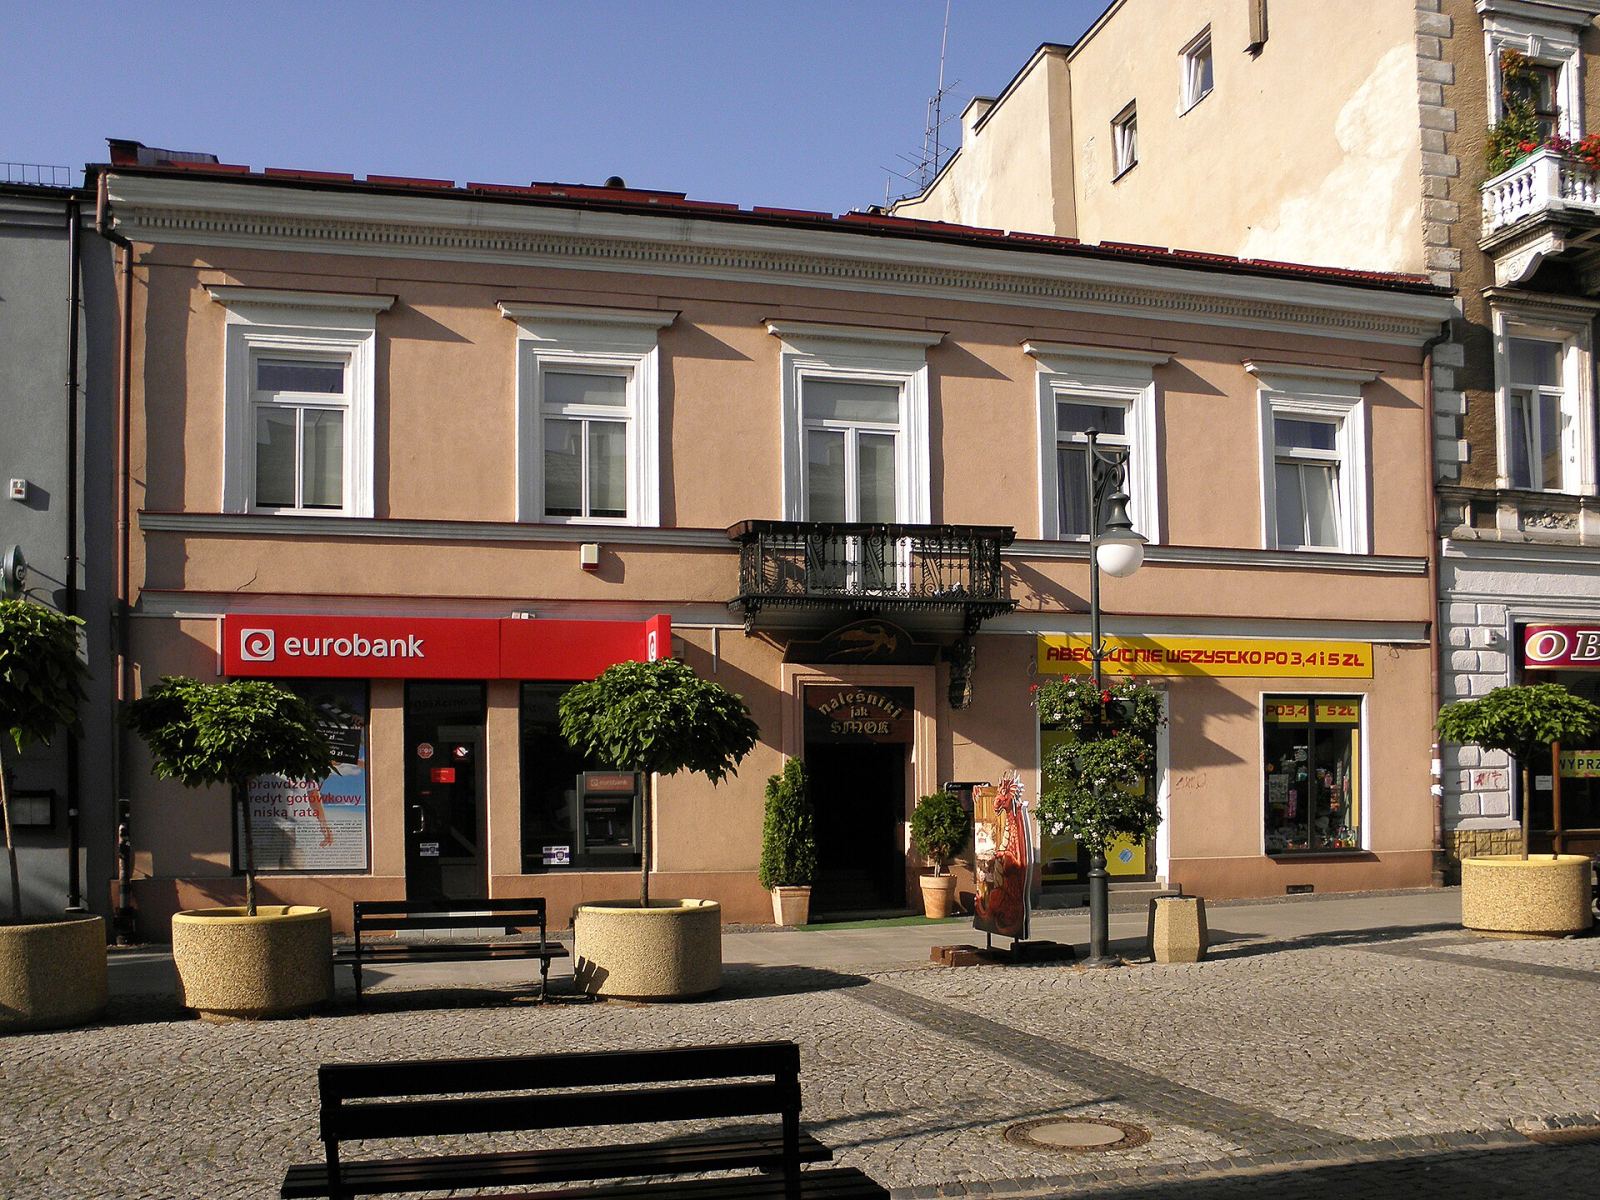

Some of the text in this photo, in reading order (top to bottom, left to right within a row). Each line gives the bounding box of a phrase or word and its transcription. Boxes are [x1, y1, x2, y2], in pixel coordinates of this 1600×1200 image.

[283, 633, 425, 658] eurobank
[1166, 648, 1262, 665] WSZYSTKO
[1264, 651, 1288, 666] PO
[1342, 653, 1365, 668] ZŁ
[850, 705, 869, 719] jak
[830, 719, 890, 735] SMOK
[248, 778, 324, 792] prawdzony
[248, 792, 362, 806] redyt gotówkowy
[253, 806, 321, 820] niską ratą
